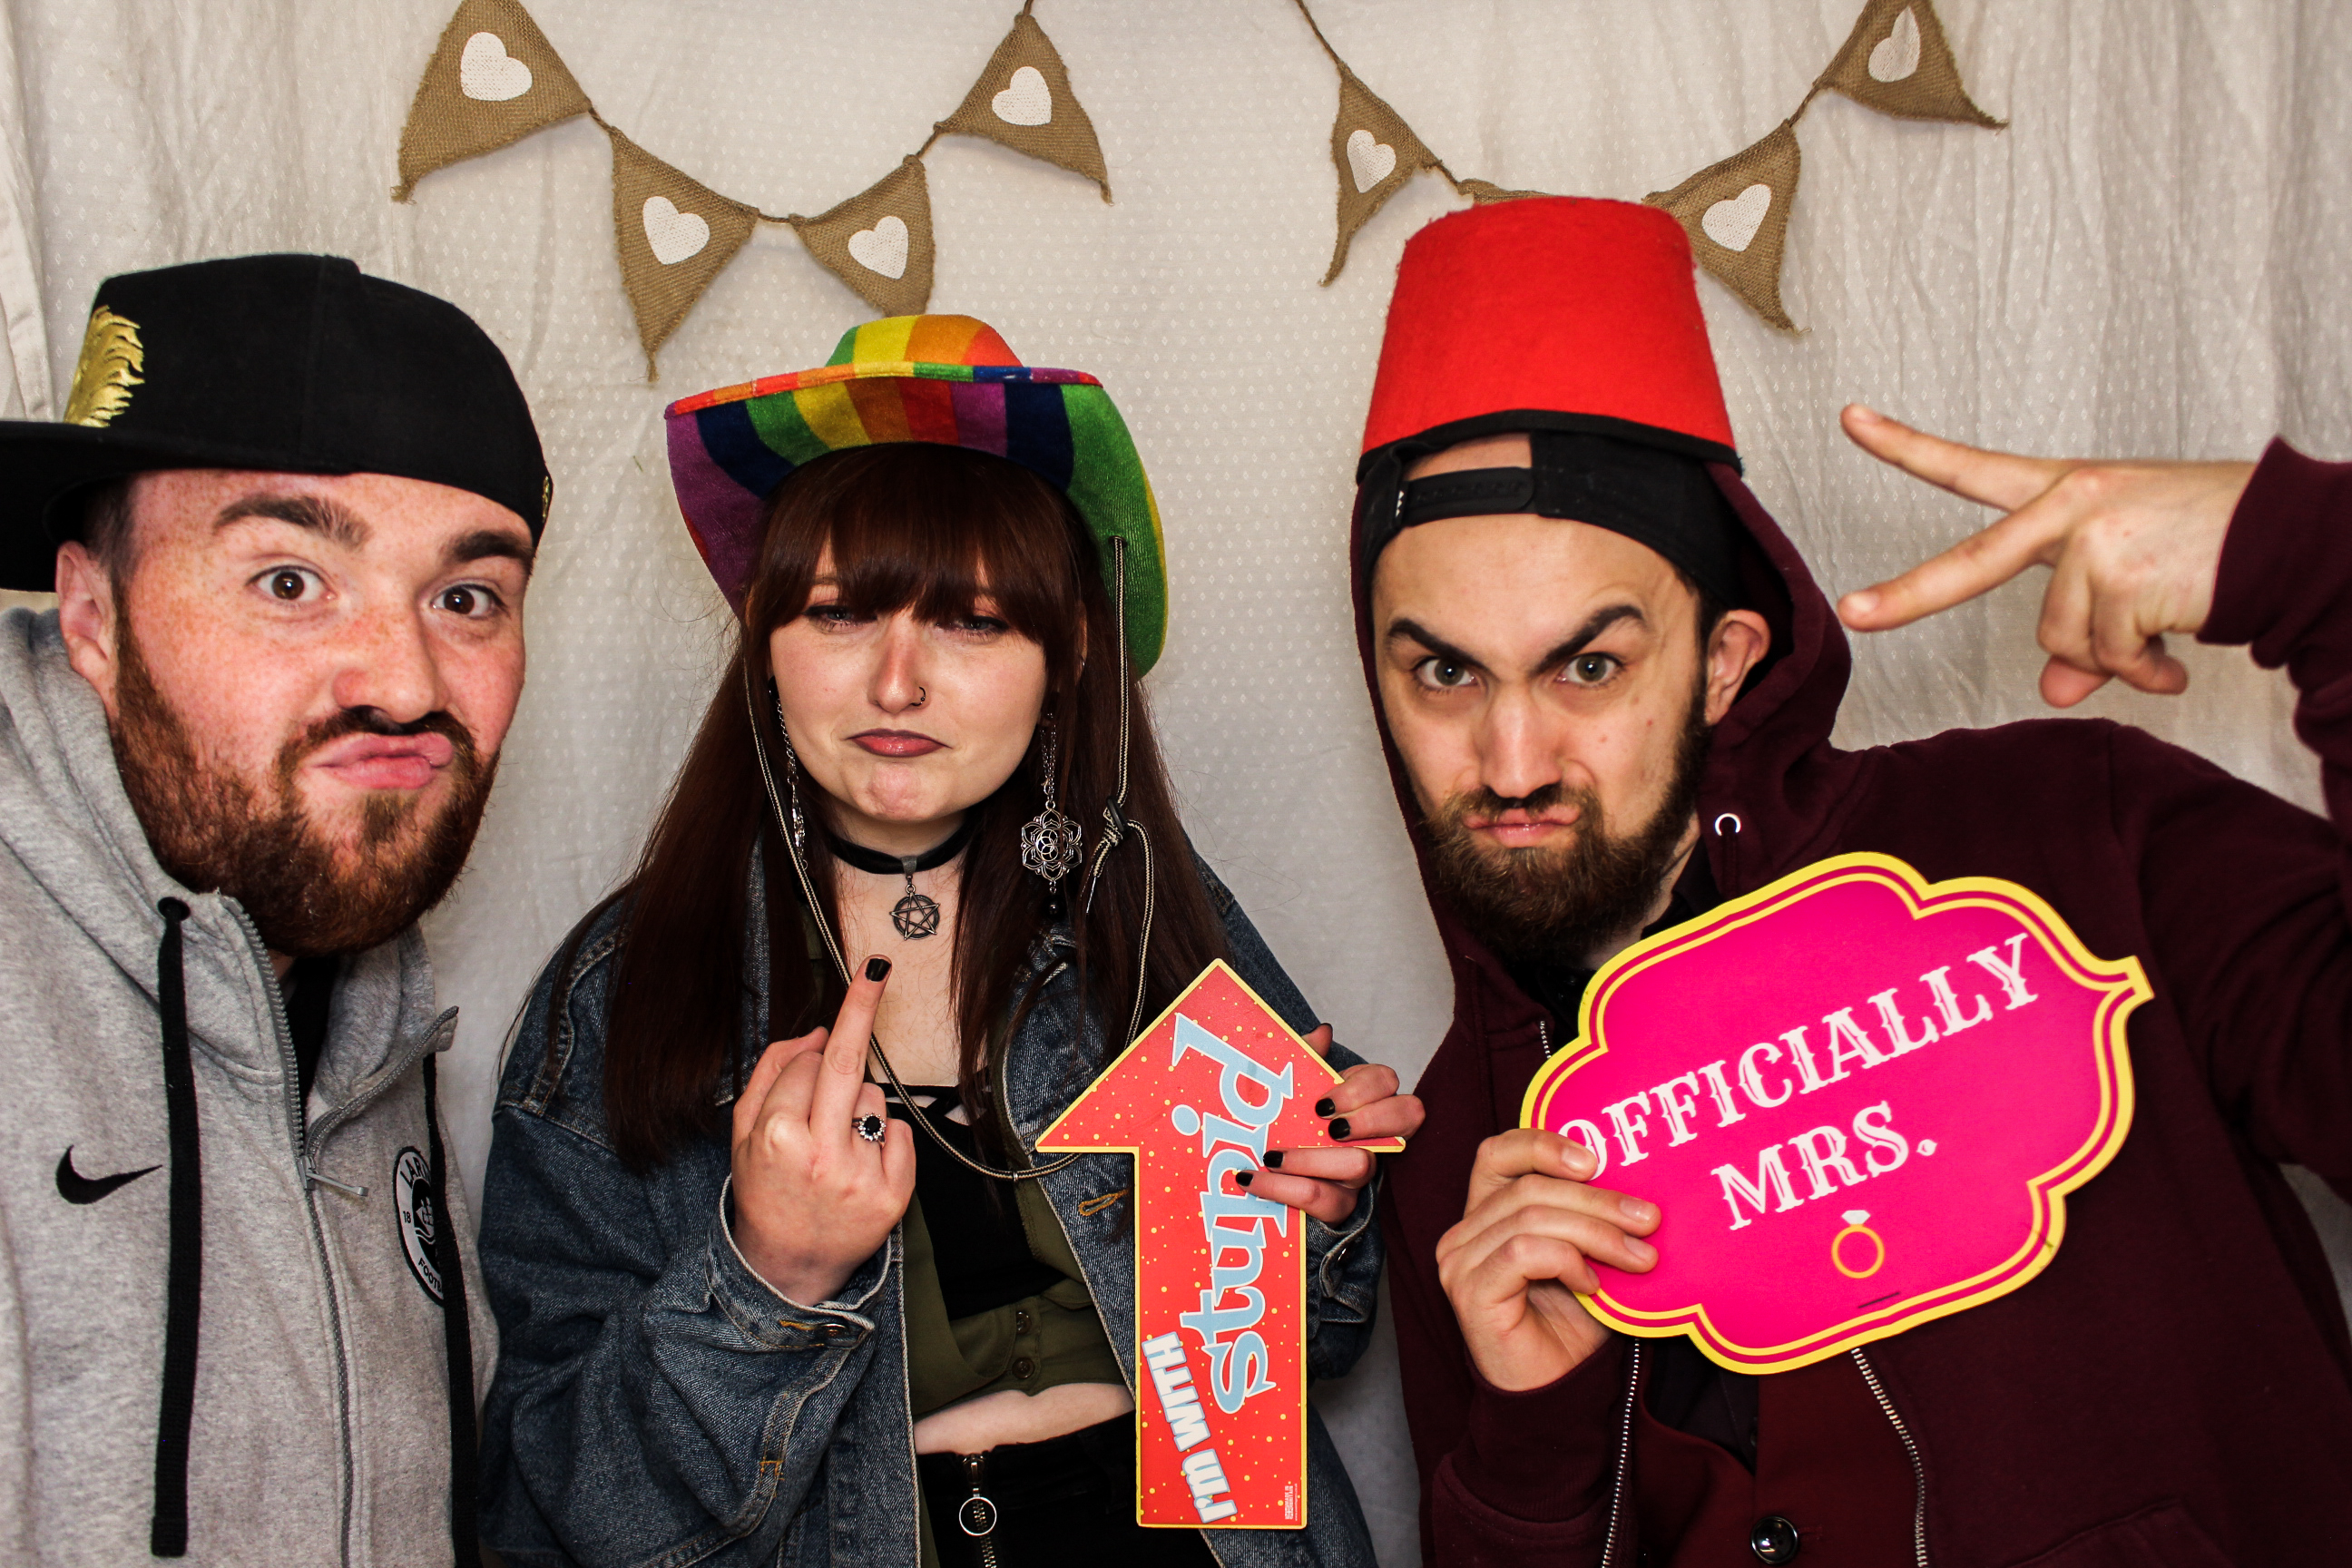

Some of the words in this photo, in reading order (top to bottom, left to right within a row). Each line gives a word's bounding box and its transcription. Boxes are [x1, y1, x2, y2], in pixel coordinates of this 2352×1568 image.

[1558, 931, 2039, 1181] OFFICIALLY
[400, 1156, 431, 1188] LARN
[1170, 1011, 1294, 1415] stupid
[1710, 1099, 1938, 1232] MRS.
[418, 1258, 442, 1292] FOOTB
[1141, 1330, 1211, 1453] WITH
